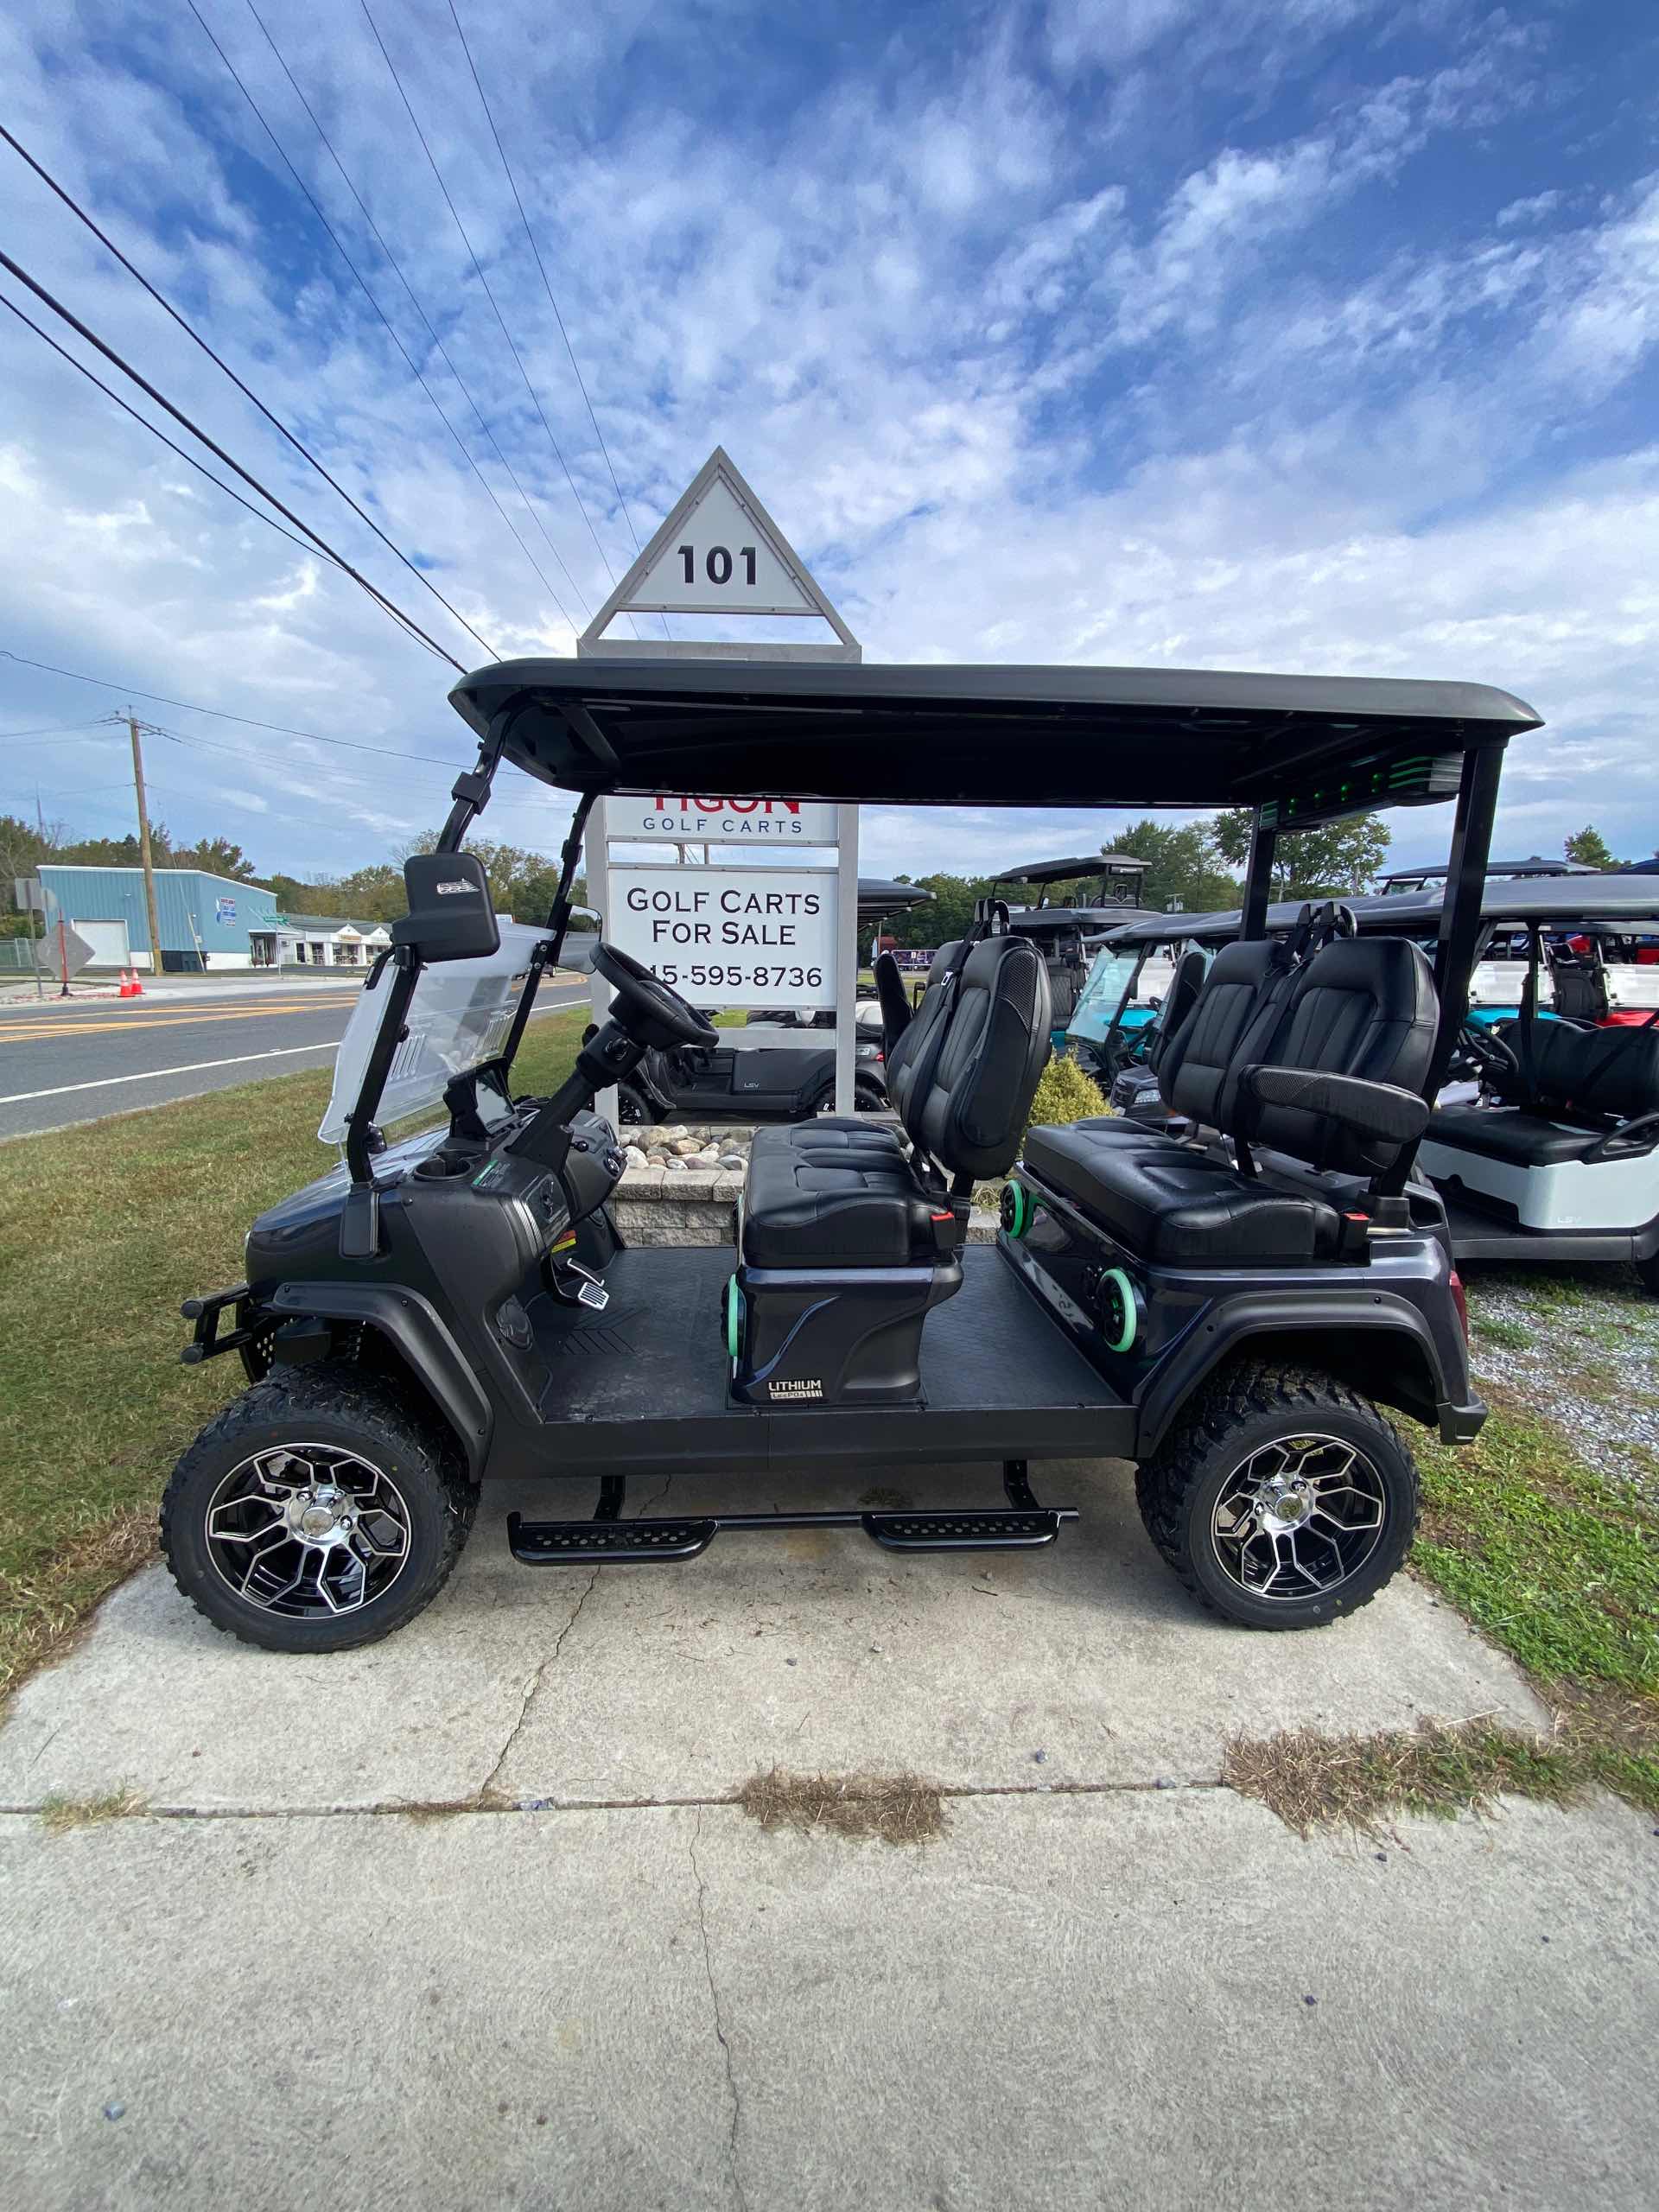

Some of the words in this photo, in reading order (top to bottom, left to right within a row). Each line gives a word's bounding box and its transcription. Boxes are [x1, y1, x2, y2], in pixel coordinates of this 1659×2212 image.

[677, 545, 756, 585] 101
[643, 817, 707, 831] GOLF
[722, 819, 802, 834] CARTS
[626, 887, 709, 912] GOLF
[720, 890, 820, 915] CARTS
[652, 919, 711, 944] FOR
[721, 921, 796, 945] SALE
[768, 1380, 821, 1391] LITHIUM
